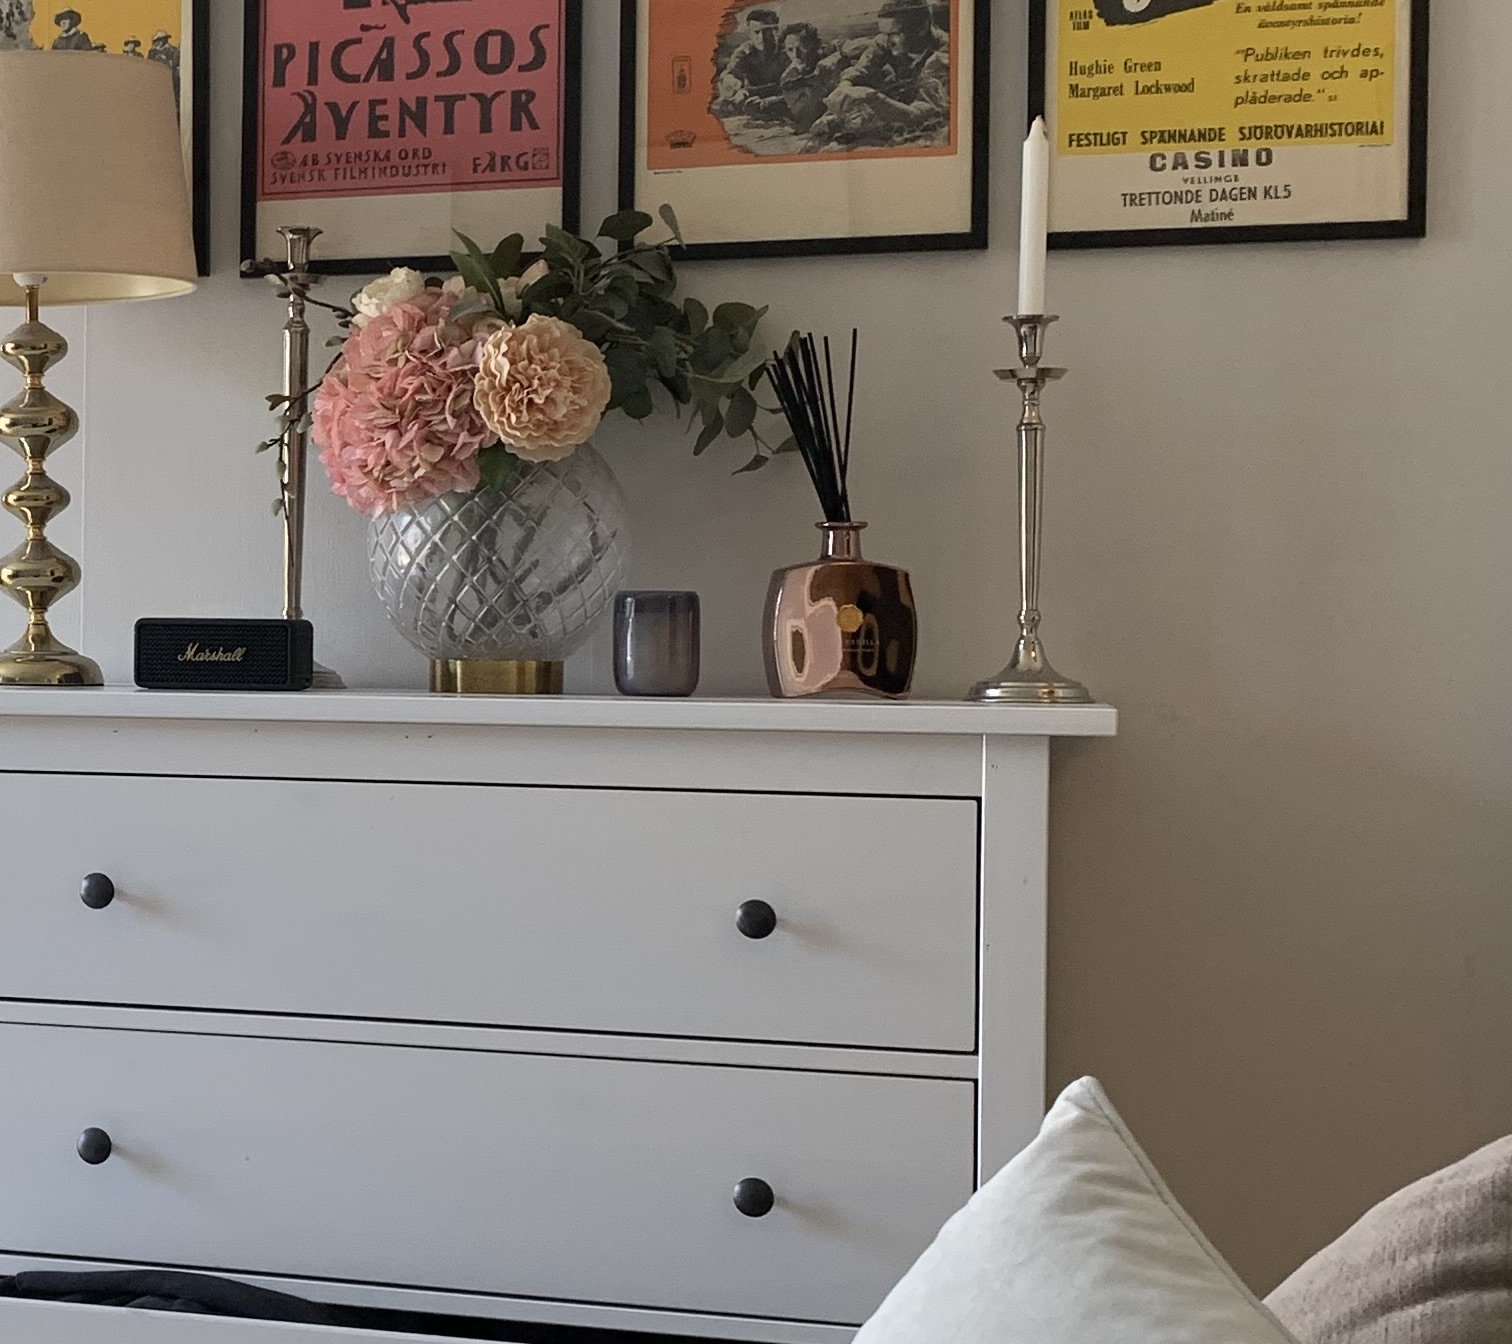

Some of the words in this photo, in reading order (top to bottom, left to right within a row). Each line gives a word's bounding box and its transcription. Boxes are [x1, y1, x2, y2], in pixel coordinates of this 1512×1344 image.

[1069, 10, 1093, 21] ATLAS
[1235, 3, 1251, 14] En
[272, 24, 550, 88] PICASSOS
[1323, 43, 1384, 59] trivdes,
[1069, 59, 1115, 78] Hughie
[1123, 58, 1162, 73] Green
[1233, 67, 1311, 84] skrattade
[1320, 65, 1349, 80] och
[1359, 68, 1385, 81] ap-
[1068, 82, 1124, 100] Margaret
[1135, 77, 1195, 96] Lockwood
[1068, 131, 1128, 148] FESTLIGT
[1140, 127, 1226, 145] SPÄNNANDE
[298, 153, 319, 167] AB
[325, 149, 391, 166] SVENSKA
[398, 147, 433, 161] ORD
[1149, 147, 1273, 172] CASINO
[270, 169, 327, 185] SVENSK
[334, 163, 446, 181] FILMINDUSTRI
[1121, 189, 1202, 207] TRETTONDE
[1209, 186, 1257, 203] DAGEN
[1190, 208, 1234, 223] Matiné
[178, 642, 246, 662] Marshall
